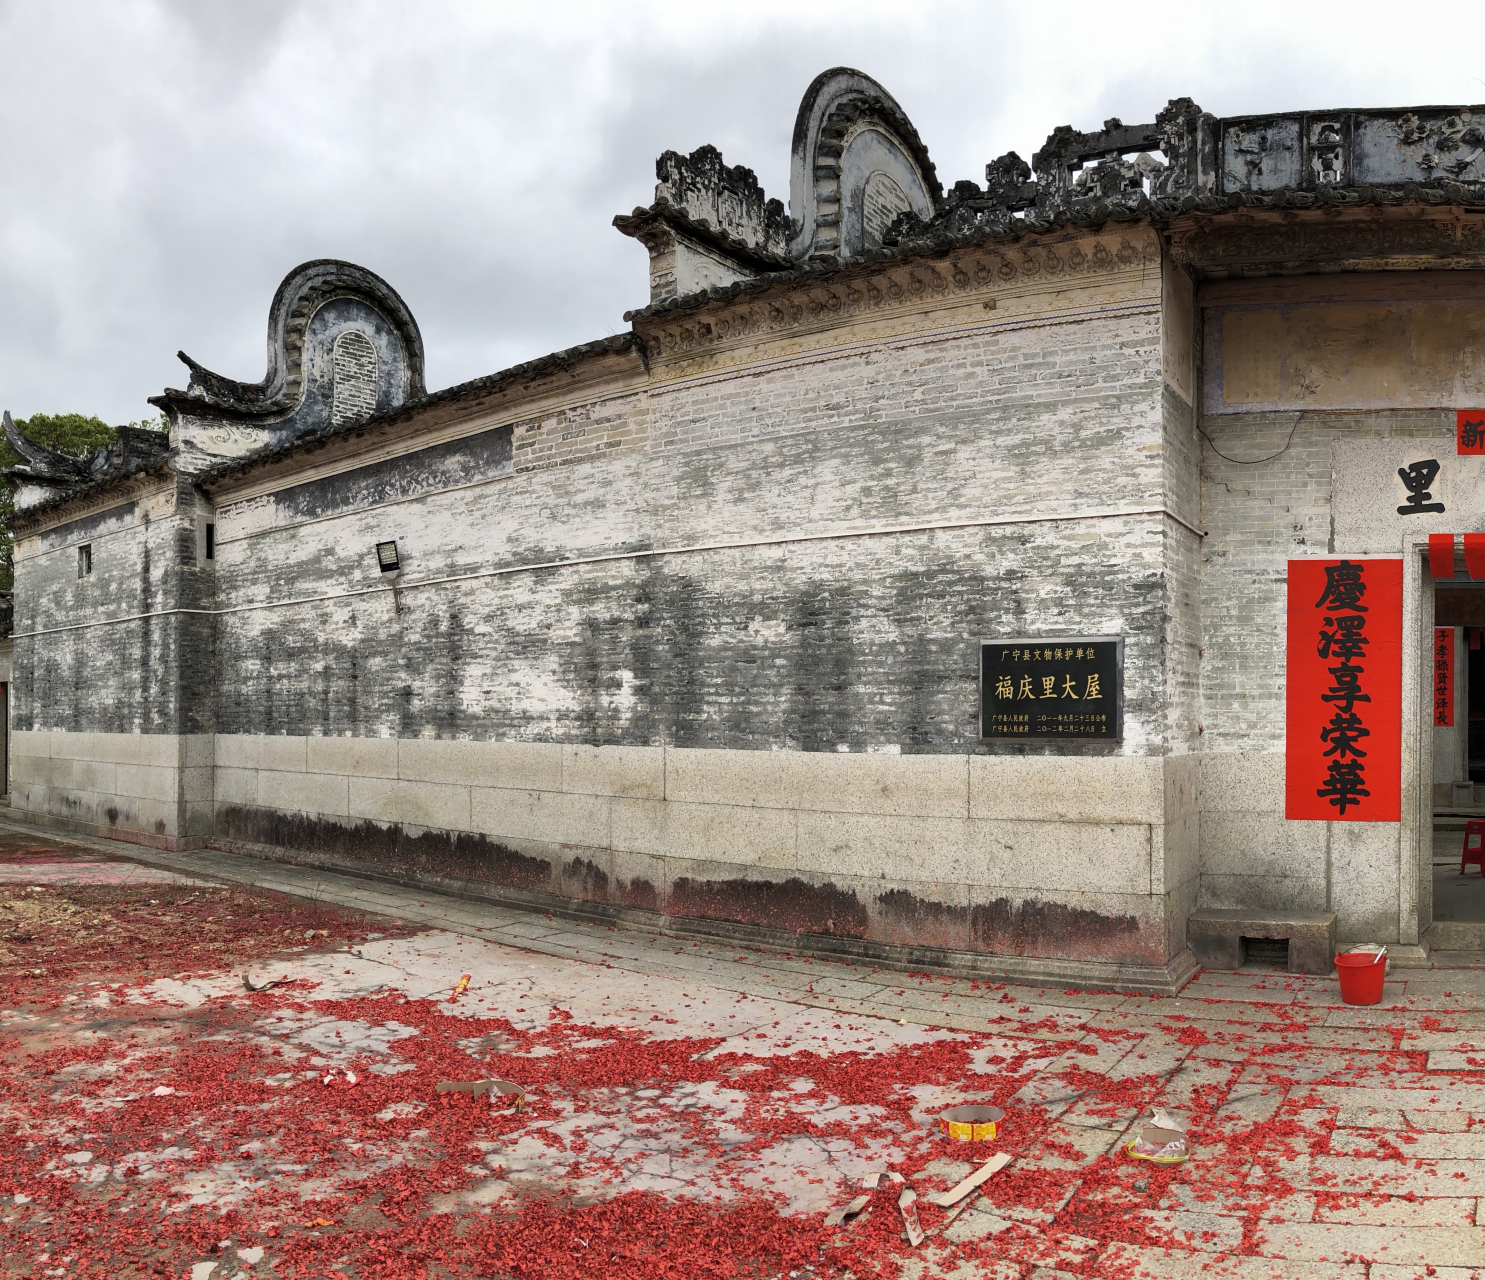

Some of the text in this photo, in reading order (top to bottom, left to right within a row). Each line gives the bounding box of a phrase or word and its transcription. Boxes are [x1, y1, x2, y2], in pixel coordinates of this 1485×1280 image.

[1001, 647, 1096, 662] 广宁县文物保护单位
[994, 673, 1103, 701] 福庆里大屋
[991, 713, 1029, 723] 广宁县人民政府
[991, 724, 1029, 733] 广宁县人民政府
